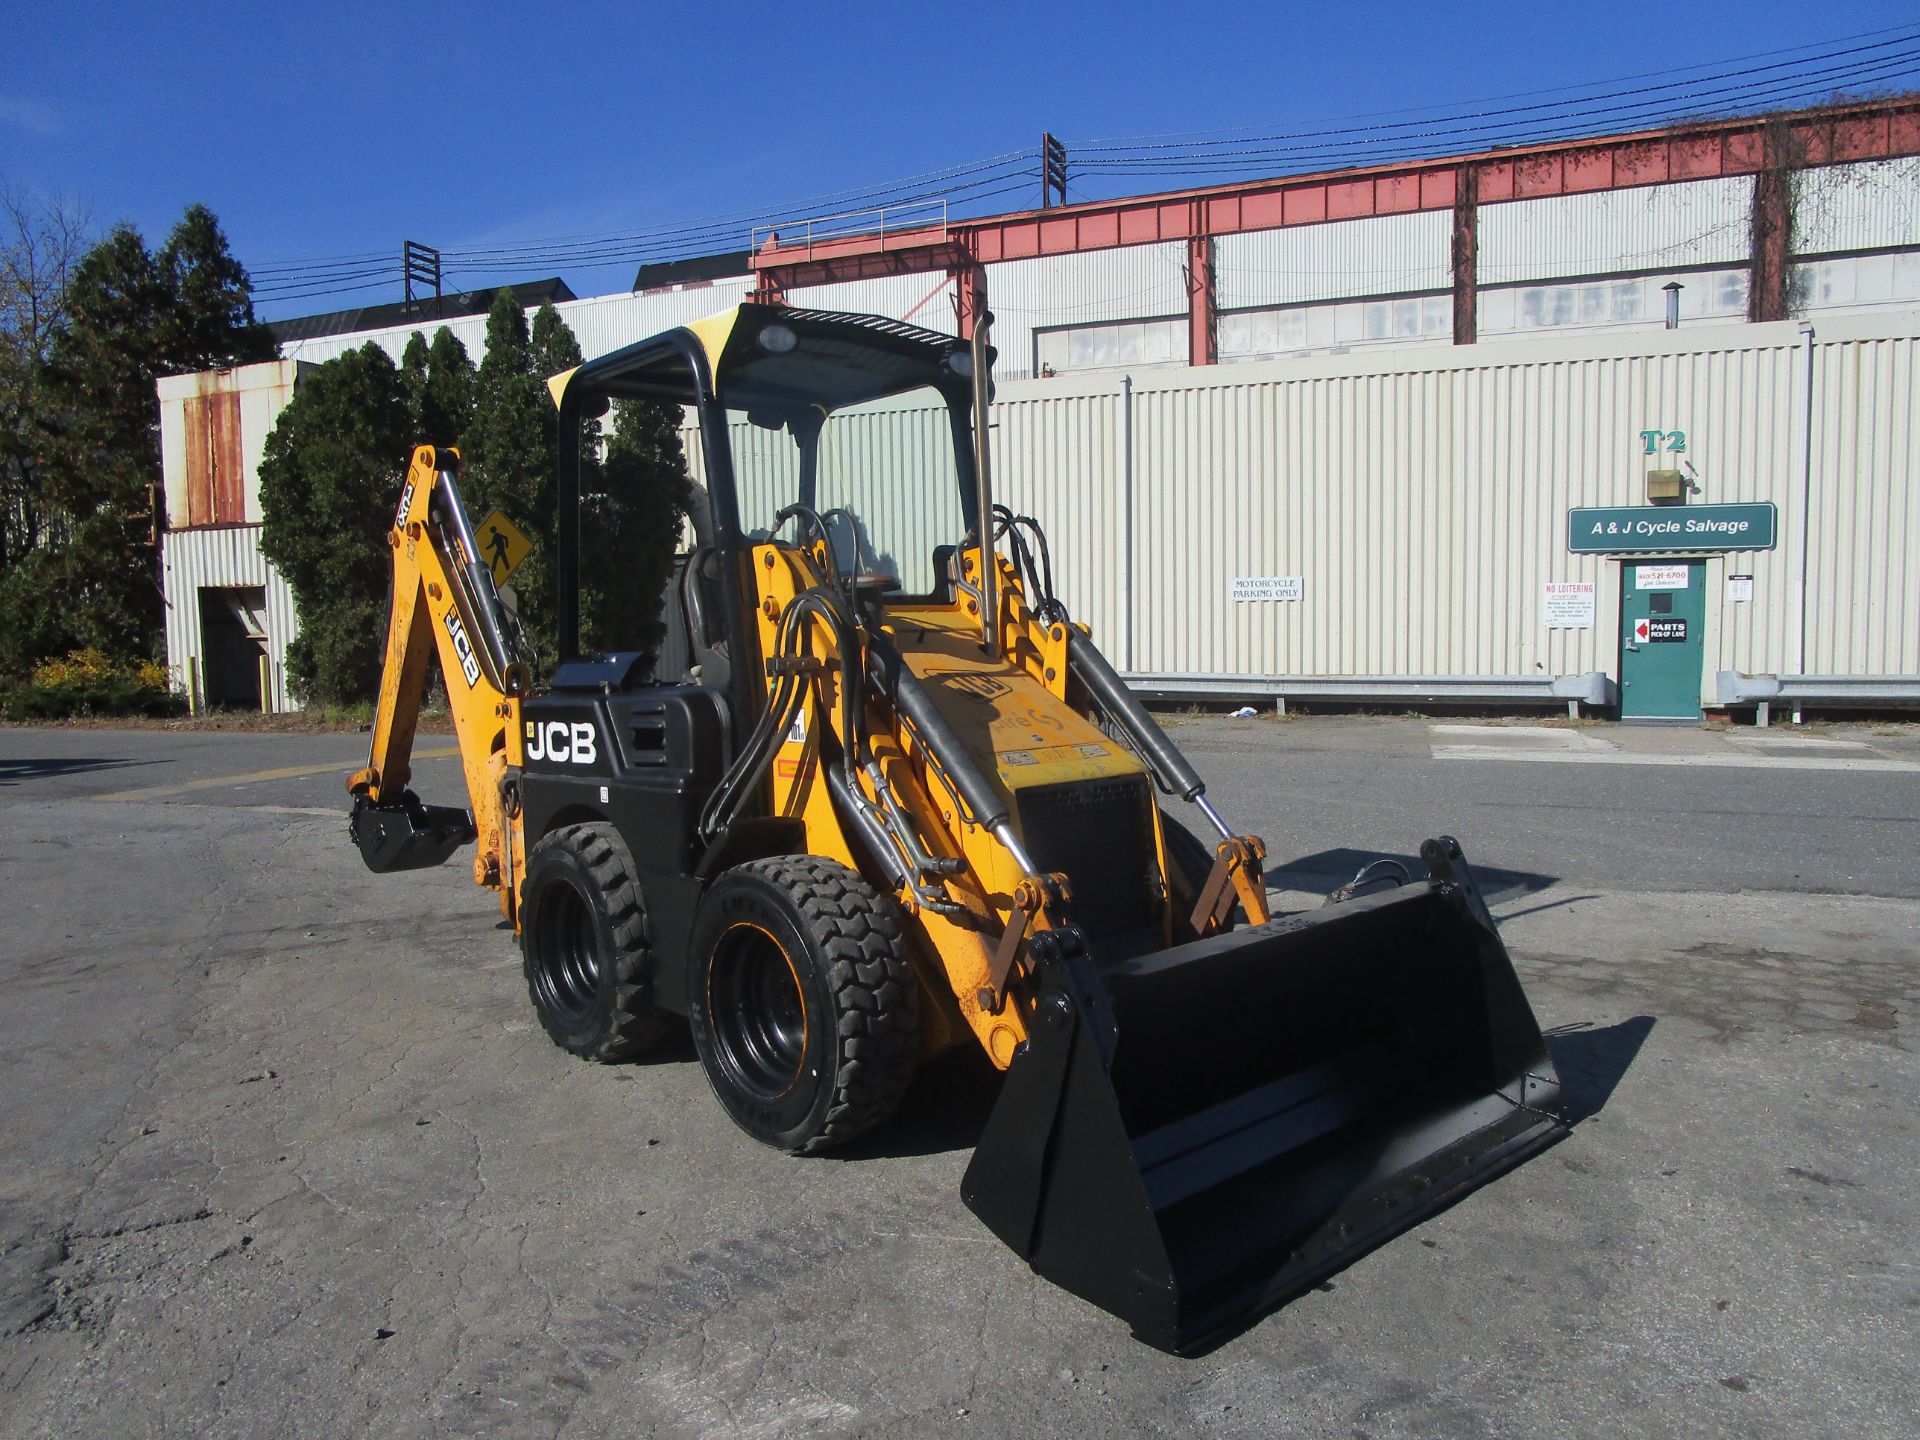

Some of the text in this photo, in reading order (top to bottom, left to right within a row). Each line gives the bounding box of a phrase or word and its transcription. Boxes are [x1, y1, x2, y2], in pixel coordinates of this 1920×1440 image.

[1639, 430, 1687, 452] T2
[1591, 519, 1749, 536] A & J Cycle Salvage
[1236, 580, 1296, 588] MOTORCYCLE
[1546, 584, 1593, 593] NO LOITERING
[1233, 589, 1298, 598] PARKING ONLY
[1650, 623, 1685, 631] PARTS
[446, 613, 480, 687] JCB
[527, 721, 597, 765] JCB
